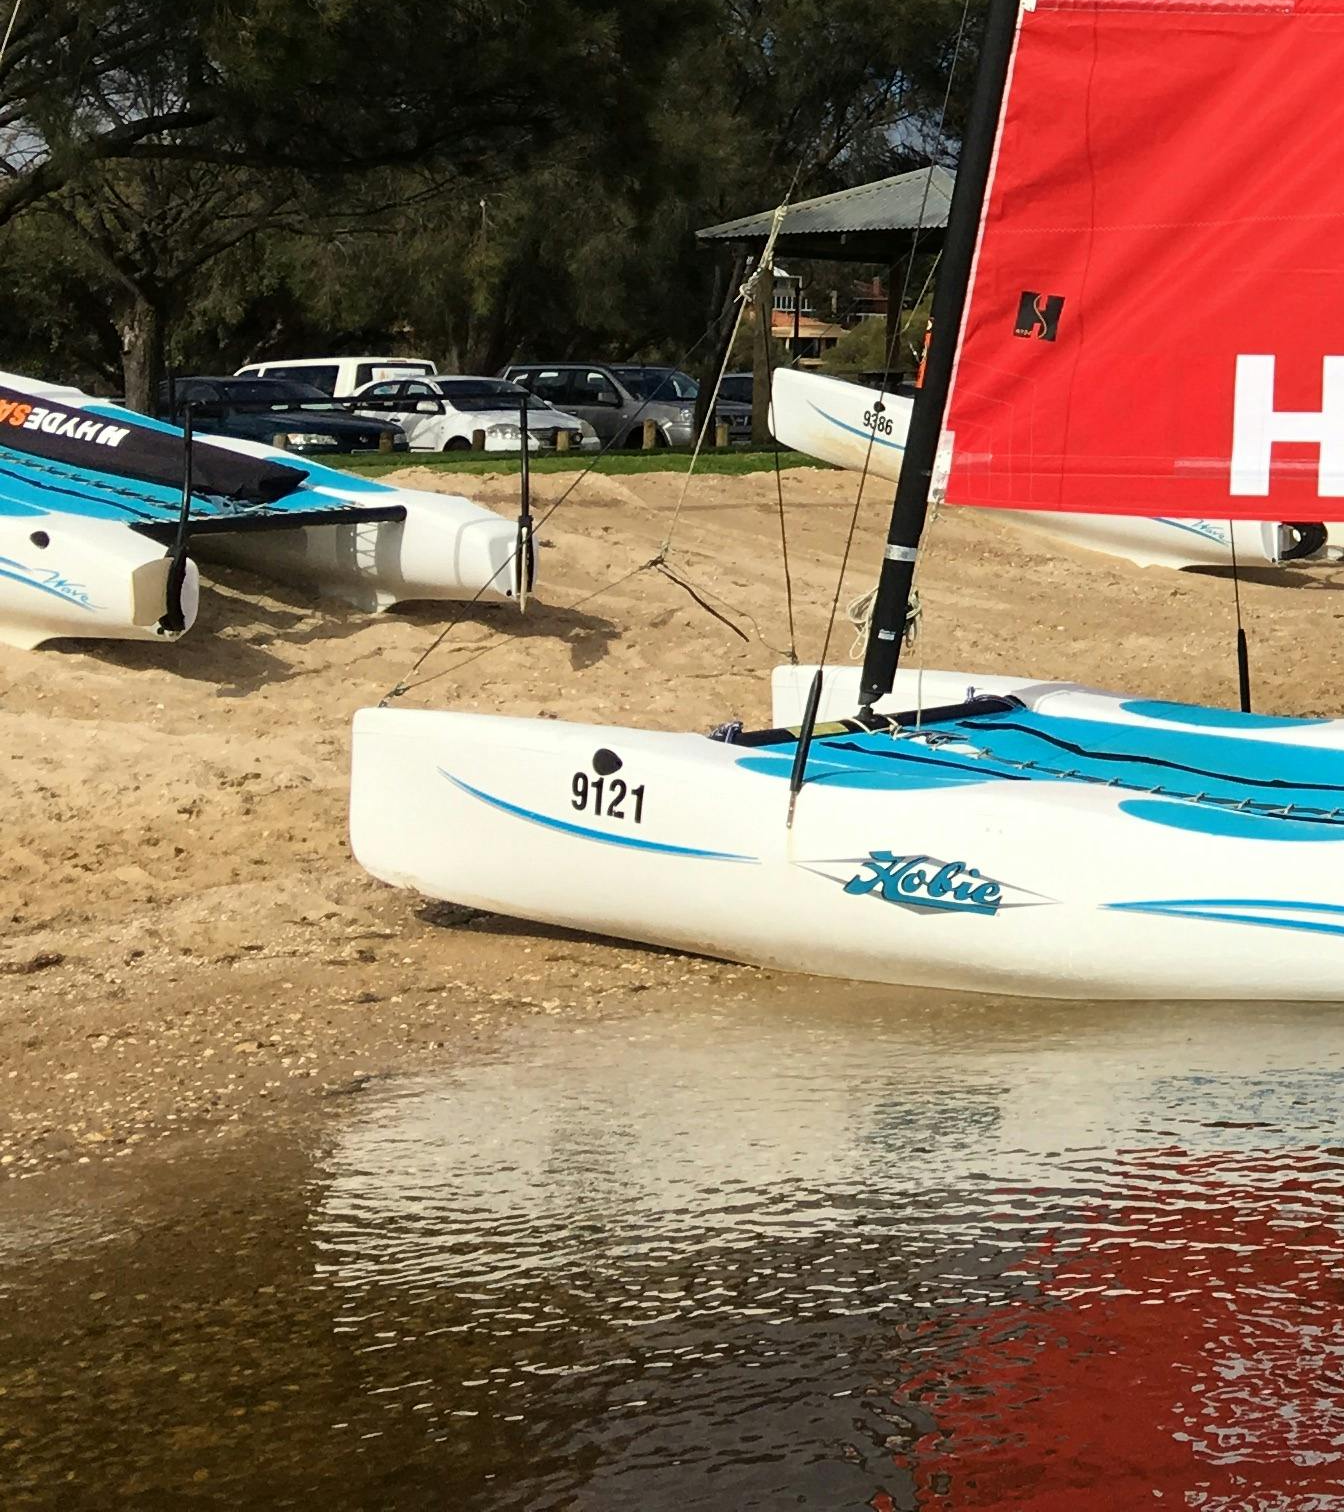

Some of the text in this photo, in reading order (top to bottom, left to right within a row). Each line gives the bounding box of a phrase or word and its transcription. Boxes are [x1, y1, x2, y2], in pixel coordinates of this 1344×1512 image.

[863, 410, 893, 435] 9386
[572, 772, 645, 824] 9121
[843, 850, 1003, 916] Hobie
